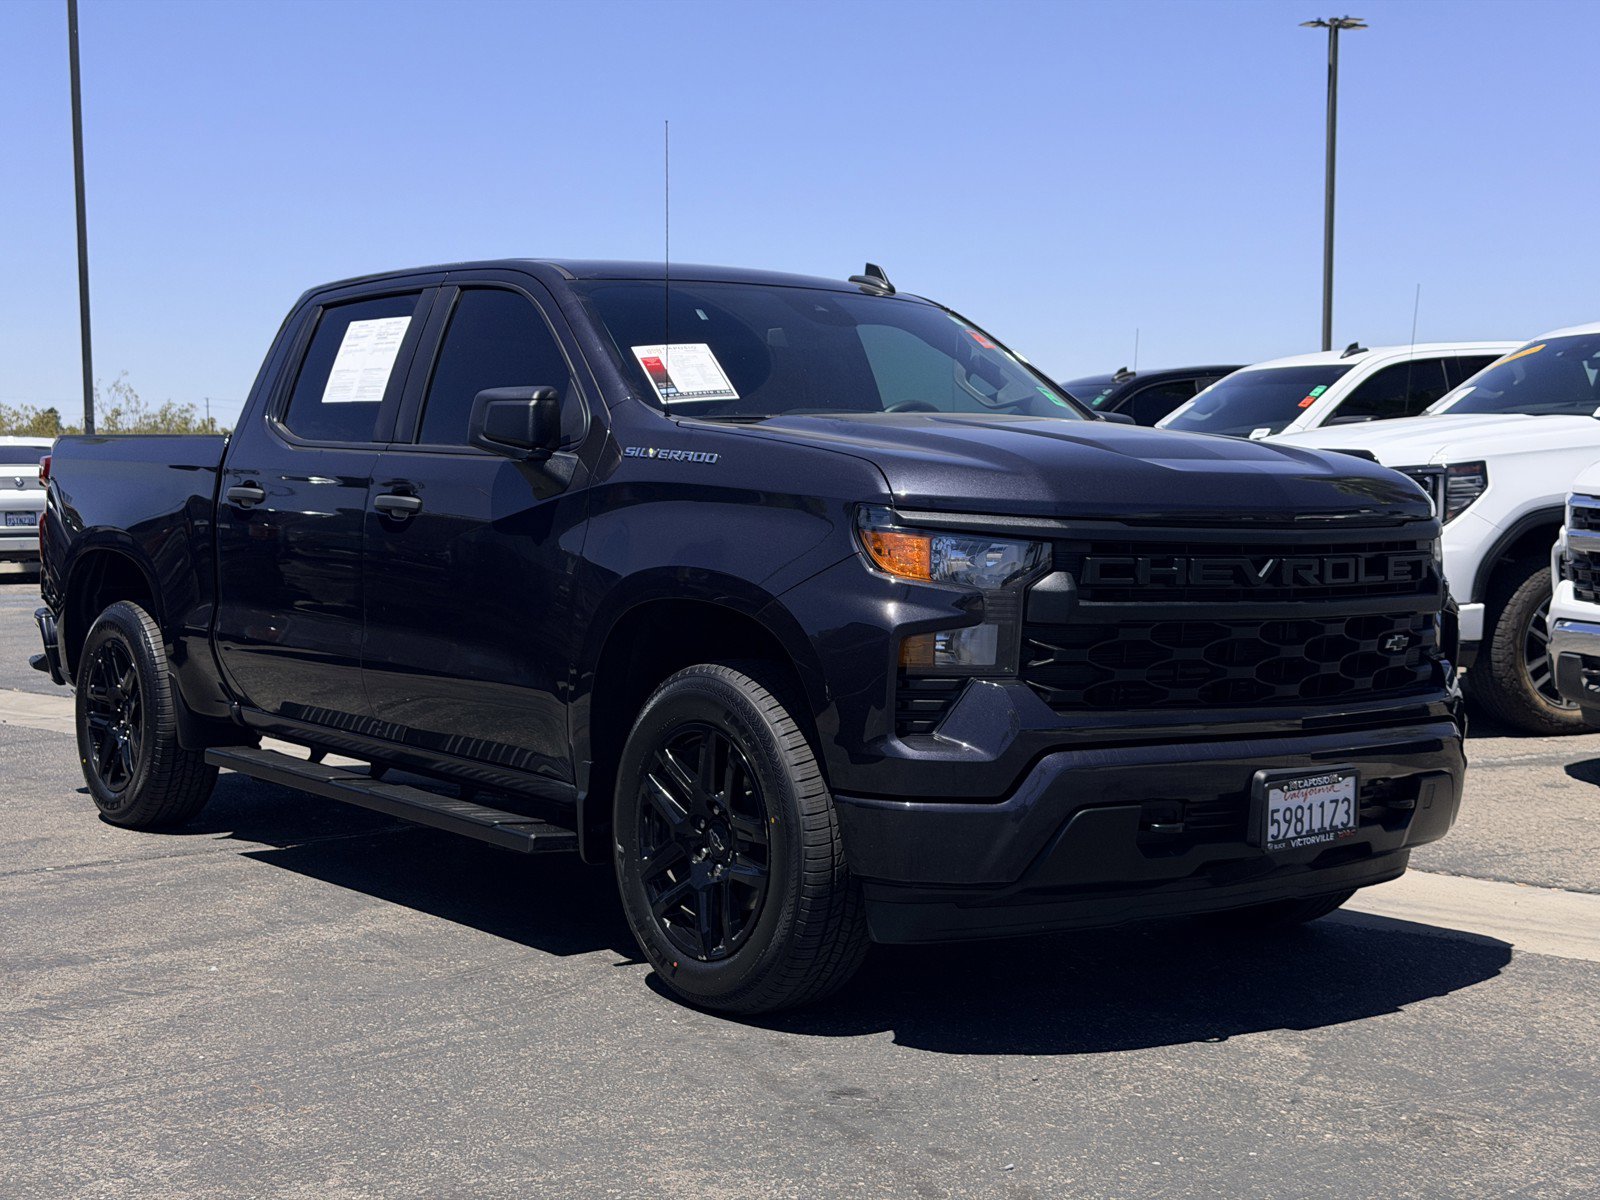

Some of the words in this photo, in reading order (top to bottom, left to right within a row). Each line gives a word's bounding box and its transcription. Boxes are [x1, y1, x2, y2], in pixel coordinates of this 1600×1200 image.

[624, 446, 718, 464] SILVERADO
[1081, 555, 1432, 585] CHEVROLET
[1270, 797, 1352, 840] 5981173
[1290, 832, 1335, 848] VICTORVILLE
